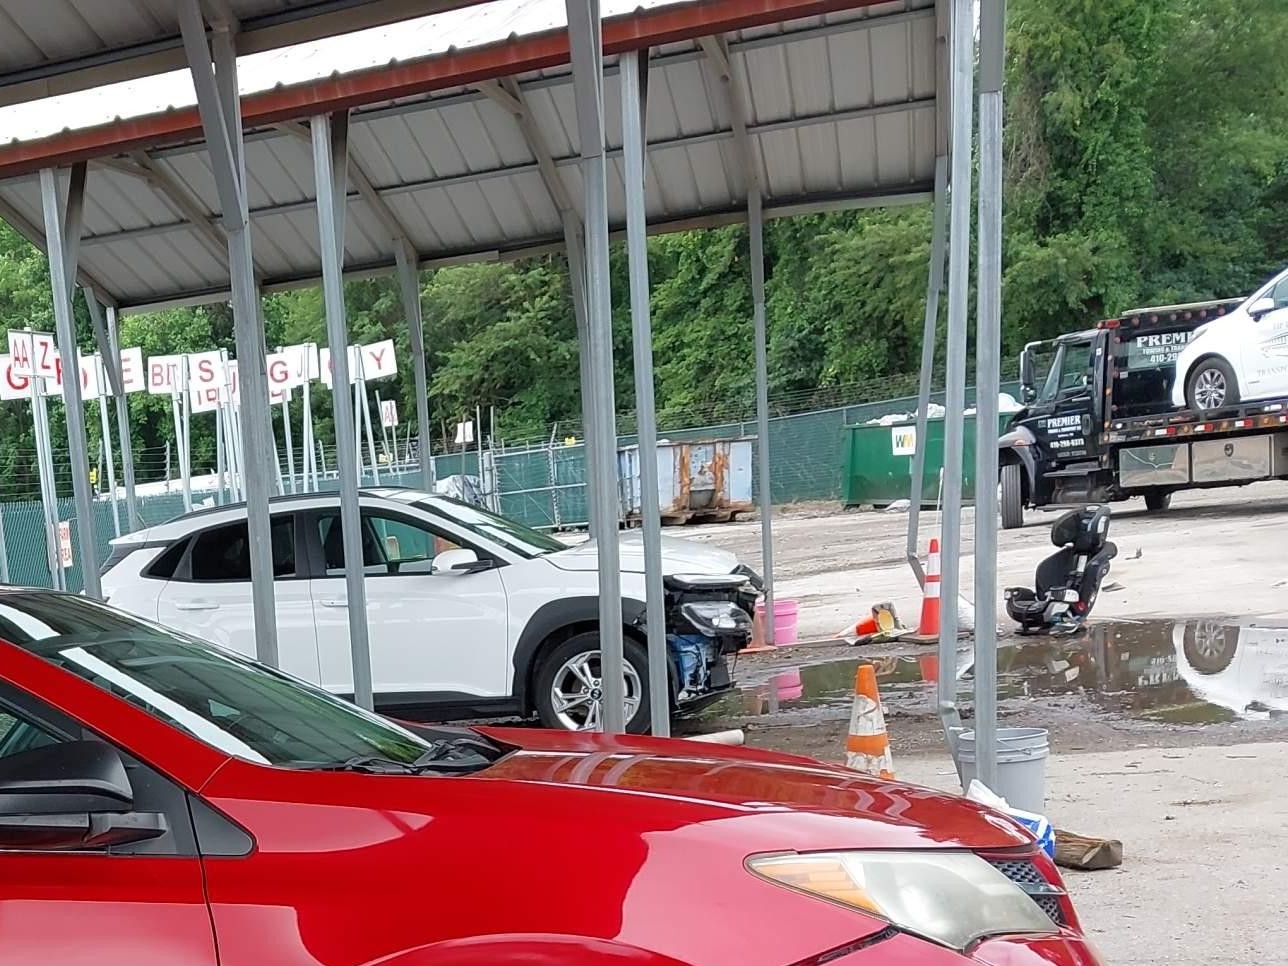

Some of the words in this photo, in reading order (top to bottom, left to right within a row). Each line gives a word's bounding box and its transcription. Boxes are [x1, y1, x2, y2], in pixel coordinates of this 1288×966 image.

[14, 339, 30, 369] AA
[39, 341, 51, 369] Z
[369, 348, 386, 370] Y
[6, 362, 29, 390] G
[198, 359, 214, 382] S
[269, 360, 289, 383] G
[1047, 414, 1081, 429] PREMIER
